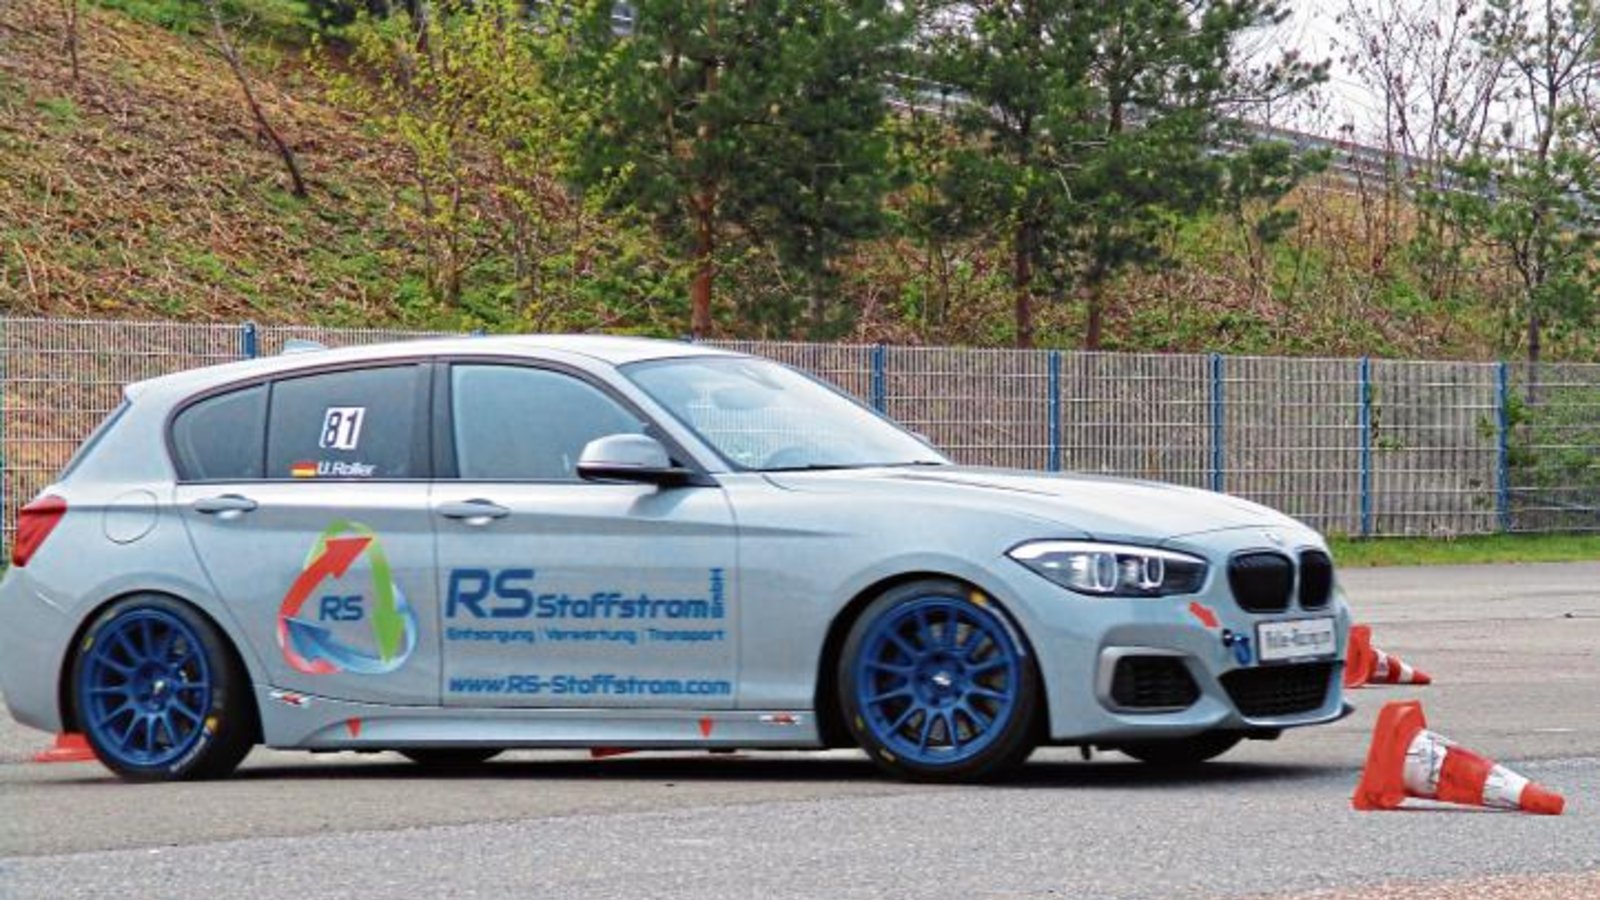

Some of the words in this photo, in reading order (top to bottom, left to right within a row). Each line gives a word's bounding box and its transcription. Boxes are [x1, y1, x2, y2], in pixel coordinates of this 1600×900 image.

[325, 410, 359, 447] 81
[446, 568, 535, 618] RS
[535, 593, 708, 618] Stoffstrom
[319, 595, 364, 621] RS
[446, 627, 535, 644] Entsorgung
[646, 628, 725, 642] Transport
[449, 674, 731, 694] www.RS-Stoffstrom.com
